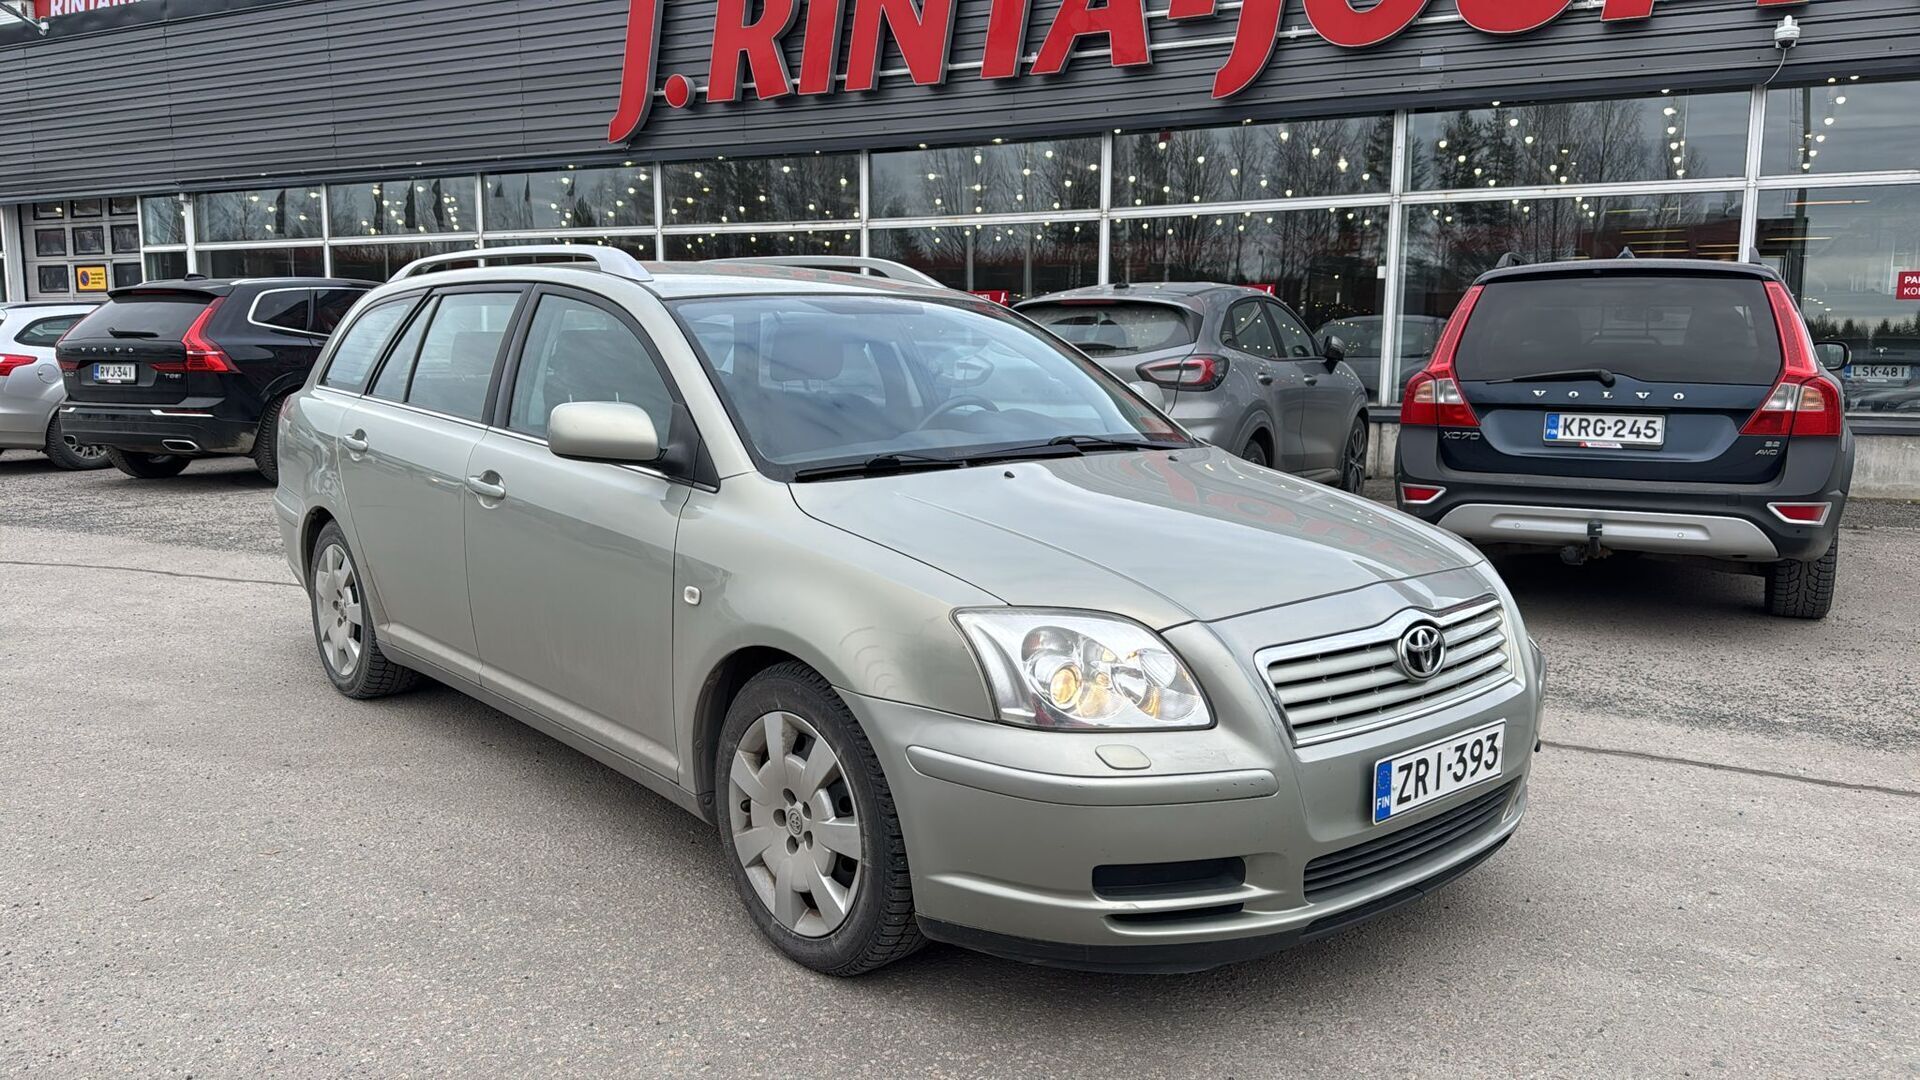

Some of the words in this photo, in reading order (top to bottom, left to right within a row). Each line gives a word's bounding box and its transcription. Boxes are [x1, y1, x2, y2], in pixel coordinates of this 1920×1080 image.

[100, 364, 132, 378] RVJ-341
[1853, 366, 1905, 377] LSK-481
[1532, 389, 1685, 401] VOLVO
[1562, 417, 1658, 439] KRG-245
[1443, 431, 1481, 440] XC70
[1396, 731, 1500, 806] ZRI-393
[1376, 795, 1390, 811] FIN
